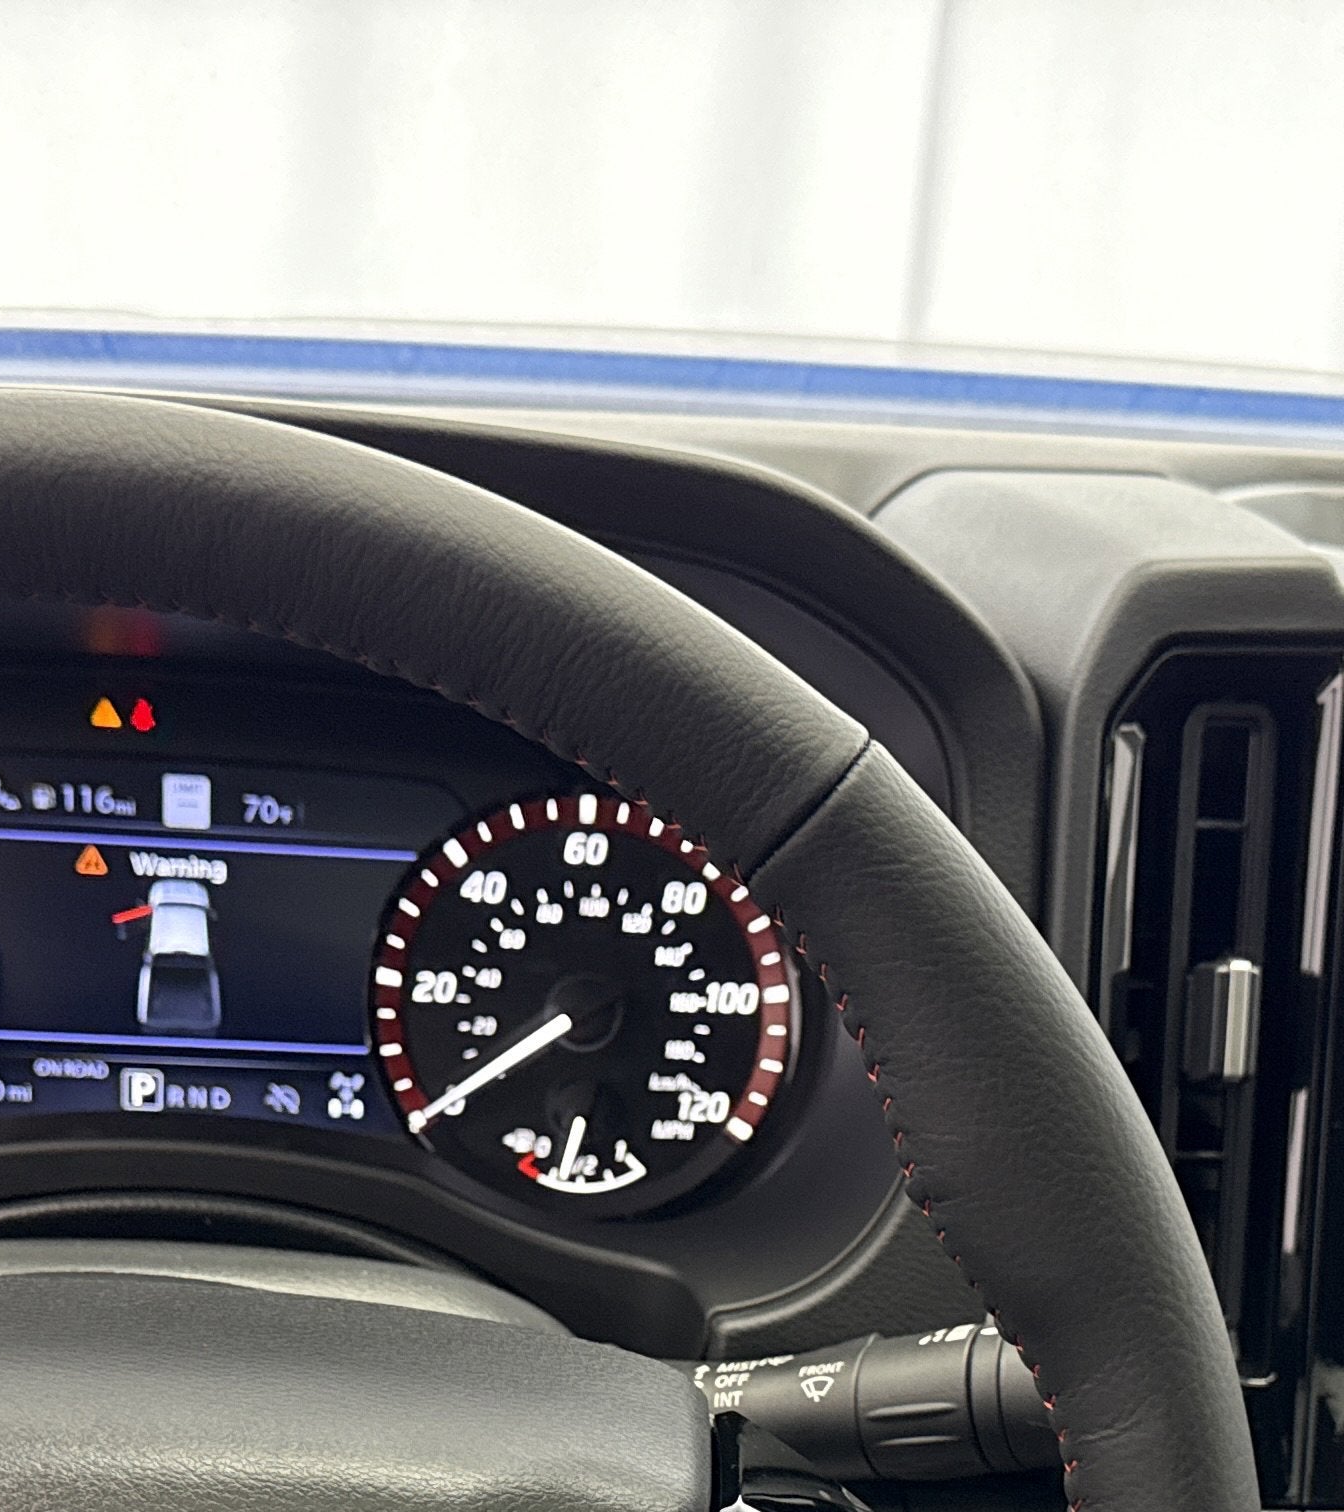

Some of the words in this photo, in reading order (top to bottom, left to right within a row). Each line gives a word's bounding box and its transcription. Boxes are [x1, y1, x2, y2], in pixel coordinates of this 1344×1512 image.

[563, 831, 609, 866] 60
[129, 850, 228, 885] Warning
[459, 870, 507, 904] 40
[661, 880, 707, 915] 80
[412, 971, 457, 1004] 20
[705, 981, 760, 1015] 100
[130, 1072, 157, 1107] P
[166, 1084, 185, 1109] R
[187, 1085, 209, 1110] N
[210, 1086, 232, 1111] D
[677, 1090, 731, 1124] 120
[714, 1372, 751, 1389] OFF
[797, 1360, 845, 1378] FRONT
[713, 1389, 744, 1408] INT
